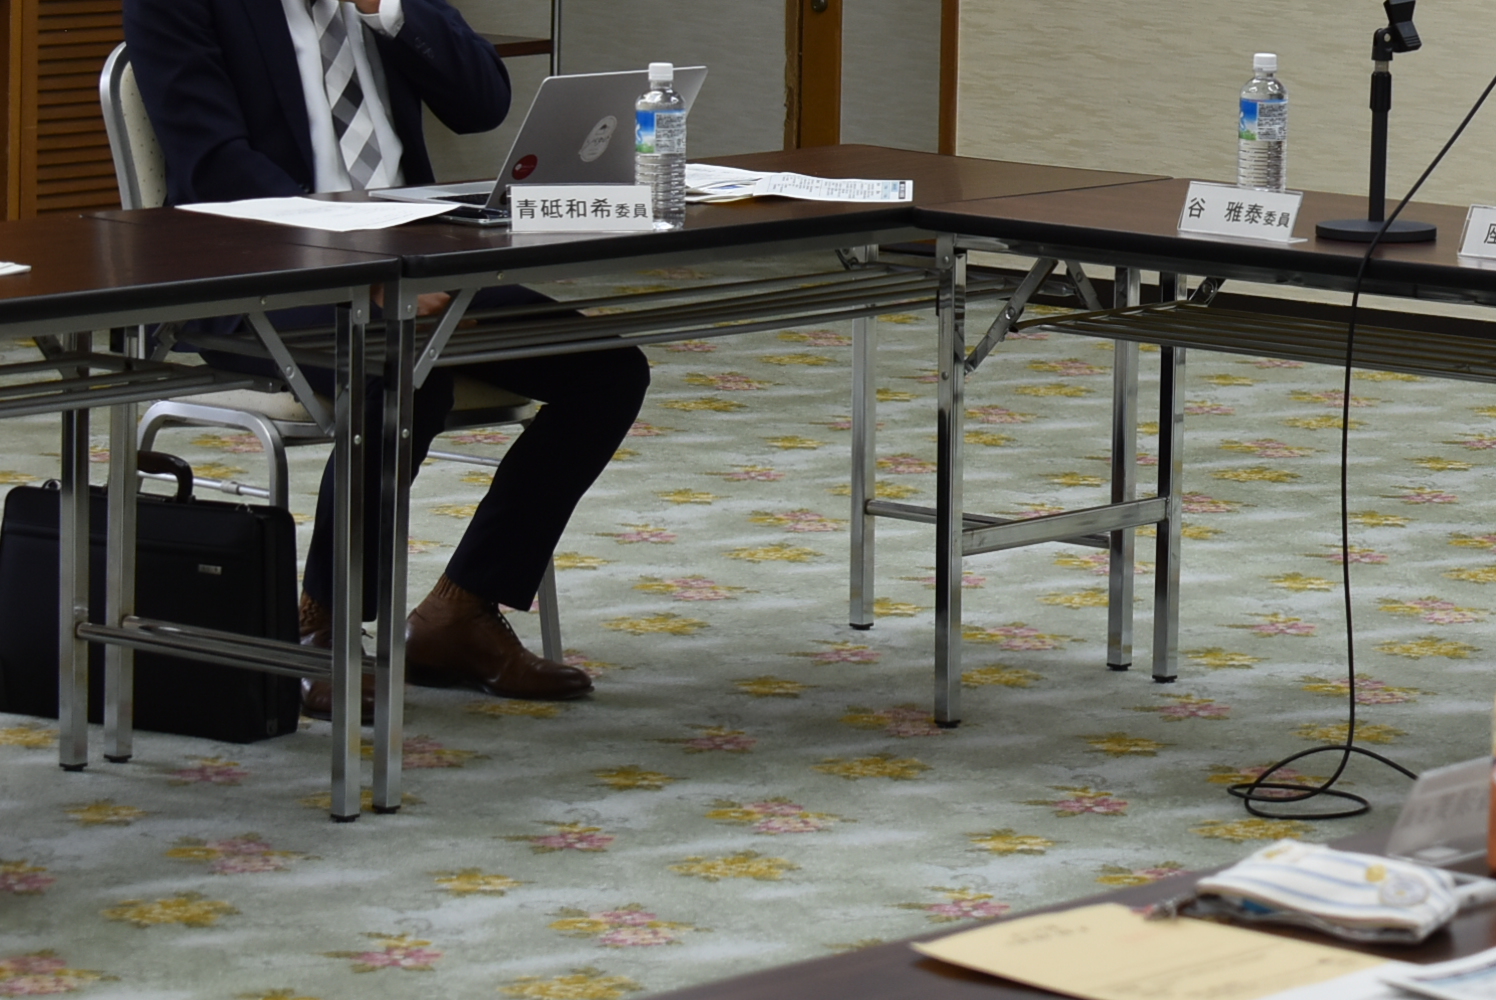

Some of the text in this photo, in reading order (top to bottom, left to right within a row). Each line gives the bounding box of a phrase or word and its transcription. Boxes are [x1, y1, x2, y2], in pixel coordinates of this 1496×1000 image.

[516, 198, 648, 219] 青砥和希委員
[1188, 197, 1291, 228] 谷 雅泰委員
